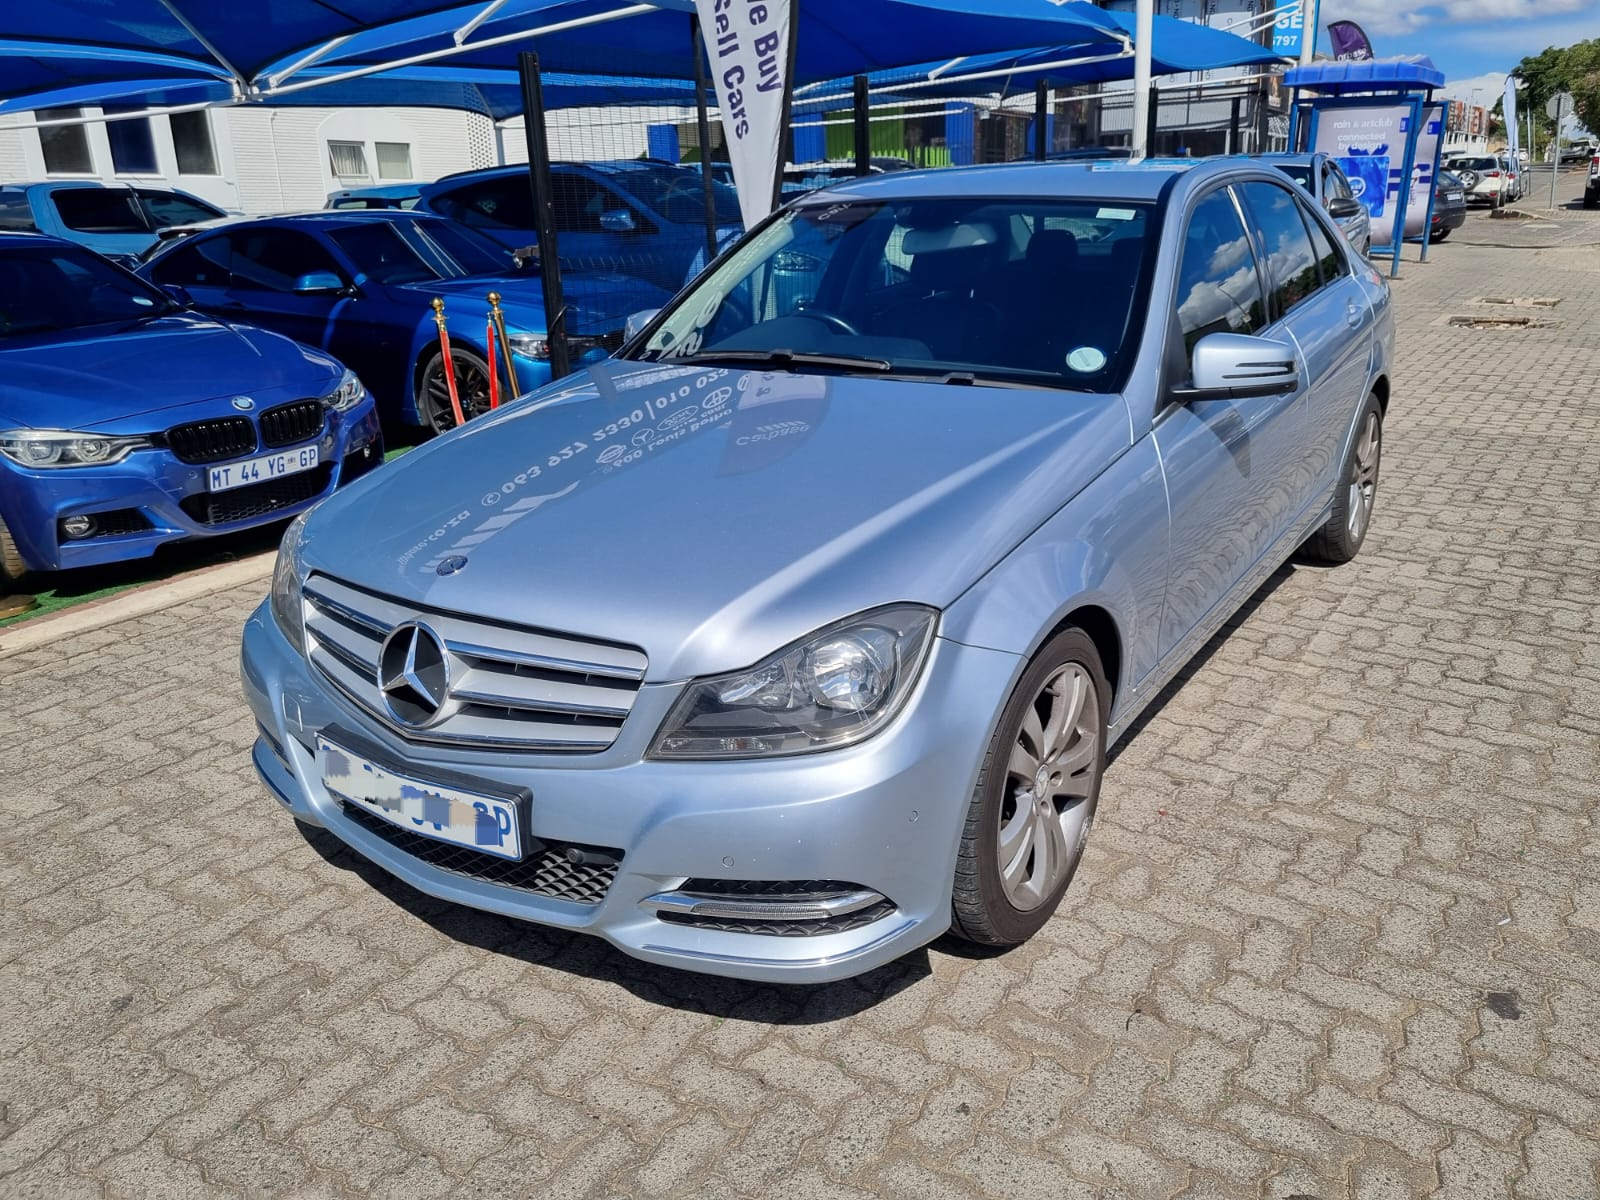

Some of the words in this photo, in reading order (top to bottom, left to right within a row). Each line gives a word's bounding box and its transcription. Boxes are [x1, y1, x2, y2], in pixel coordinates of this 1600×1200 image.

[747, 0, 768, 26] e
[1272, 35, 1298, 47] 797
[754, 30, 782, 93] Buy
[723, 64, 749, 140] Cars
[1337, 132, 1386, 141] connected
[1338, 142, 1349, 153] by
[1350, 141, 1383, 151] design
[212, 468, 231, 490] MT
[241, 462, 259, 481] 44
[268, 456, 285, 476] YG
[299, 448, 317, 467] GP
